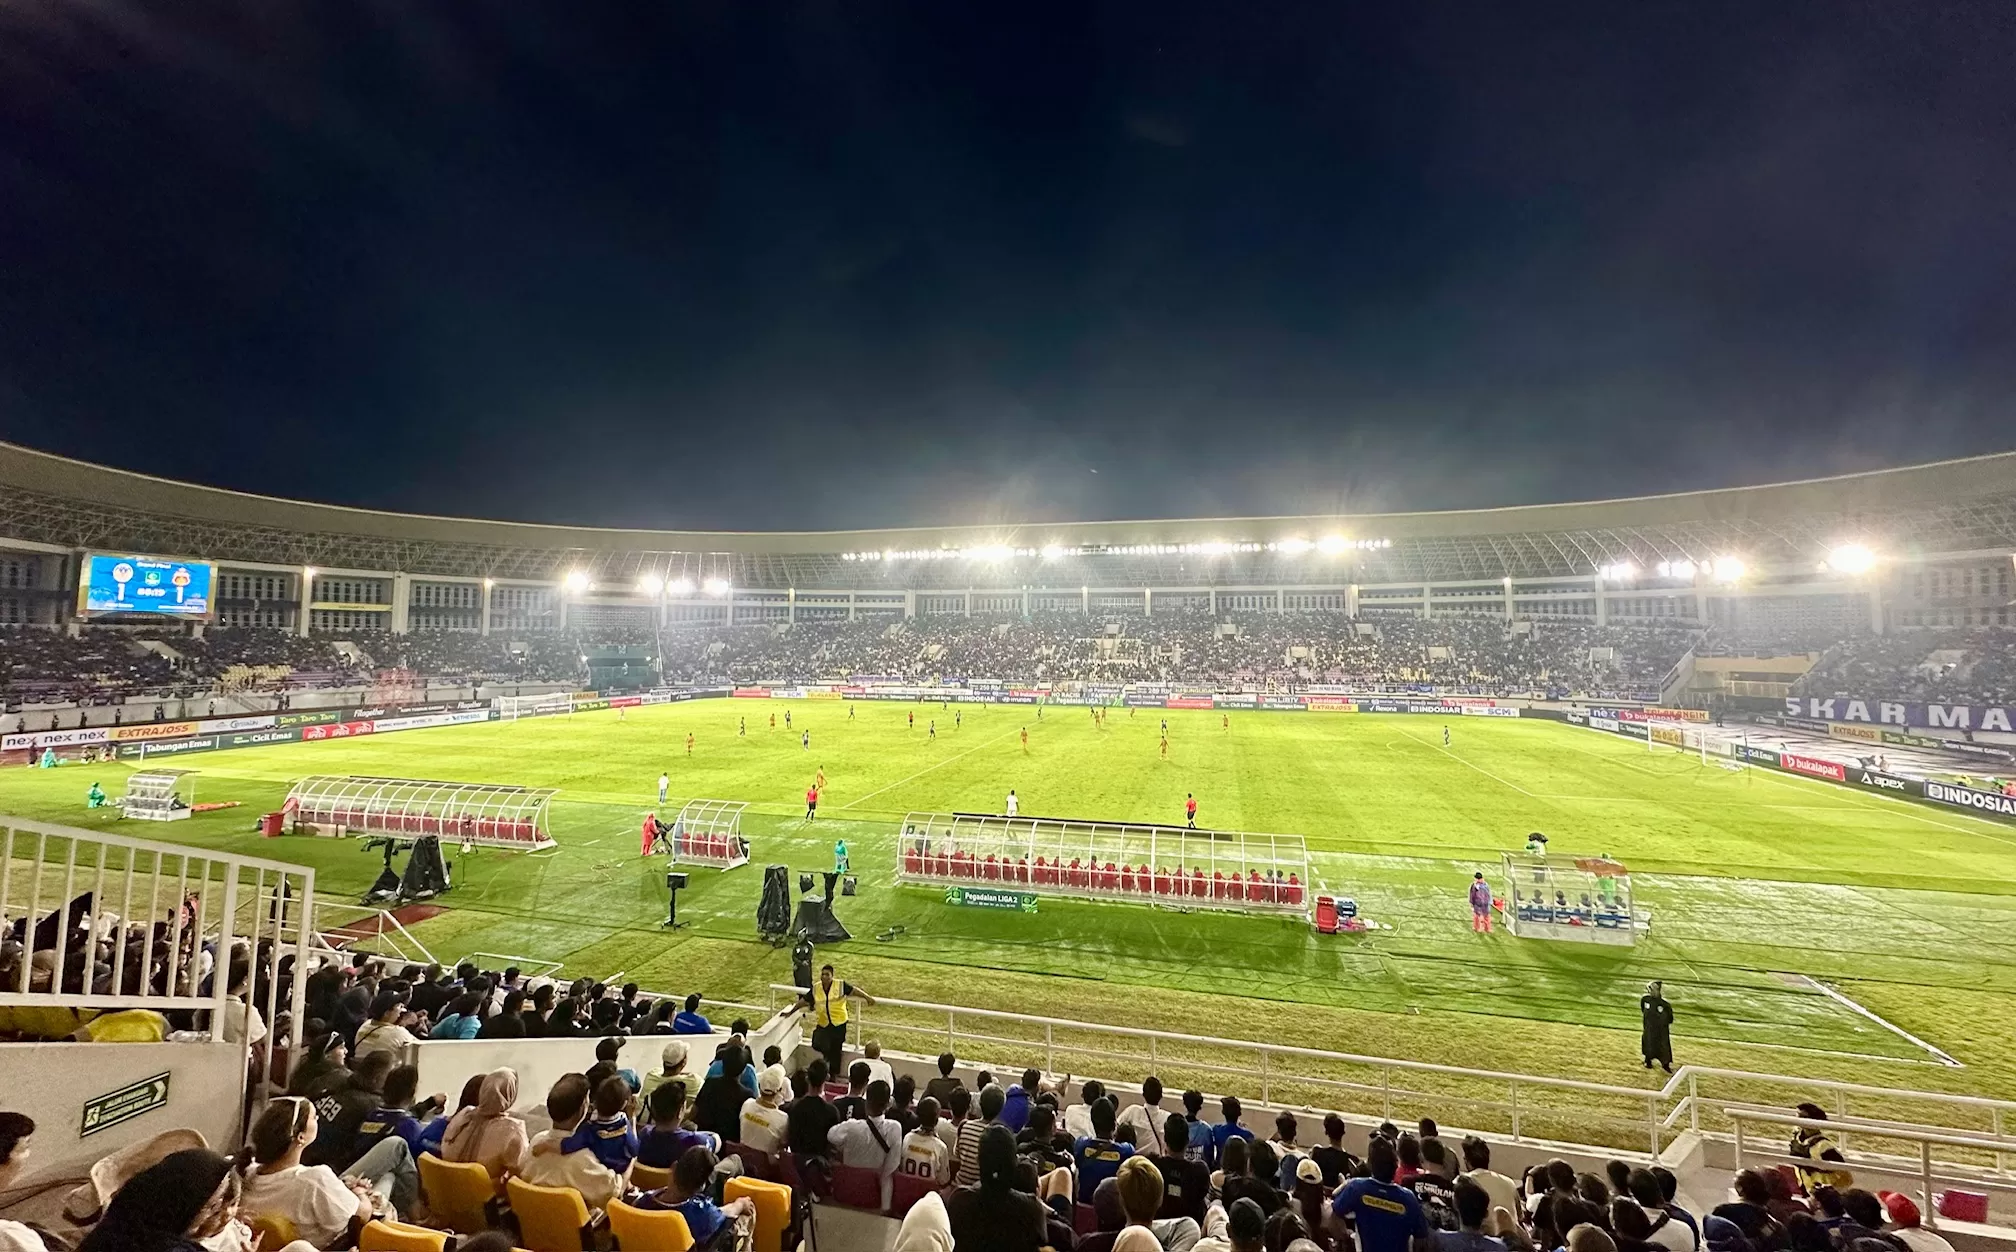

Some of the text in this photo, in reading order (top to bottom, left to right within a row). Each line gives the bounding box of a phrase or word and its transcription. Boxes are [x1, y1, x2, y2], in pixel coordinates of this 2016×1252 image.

[280, 713, 336, 724] Taro Taro Taro
[354, 708, 385, 718] Fitogether
[1488, 708, 1511, 716] SCM
[1927, 704, 2013, 731] MA
[6, 730, 106, 746] nex nex nex
[118, 724, 190, 739] EXTRAJOSS
[252, 733, 270, 742] Cicil
[271, 732, 292, 741] Emas
[1833, 725, 1876, 739] EXTRAJOSS
[146, 742, 188, 753] Tabungan
[189, 739, 212, 748] Emas
[1796, 758, 1839, 776] bukalapak
[1874, 778, 1905, 790] apex
[1945, 787, 2016, 815] INDOSIA
[965, 892, 997, 902] Pegadaian
